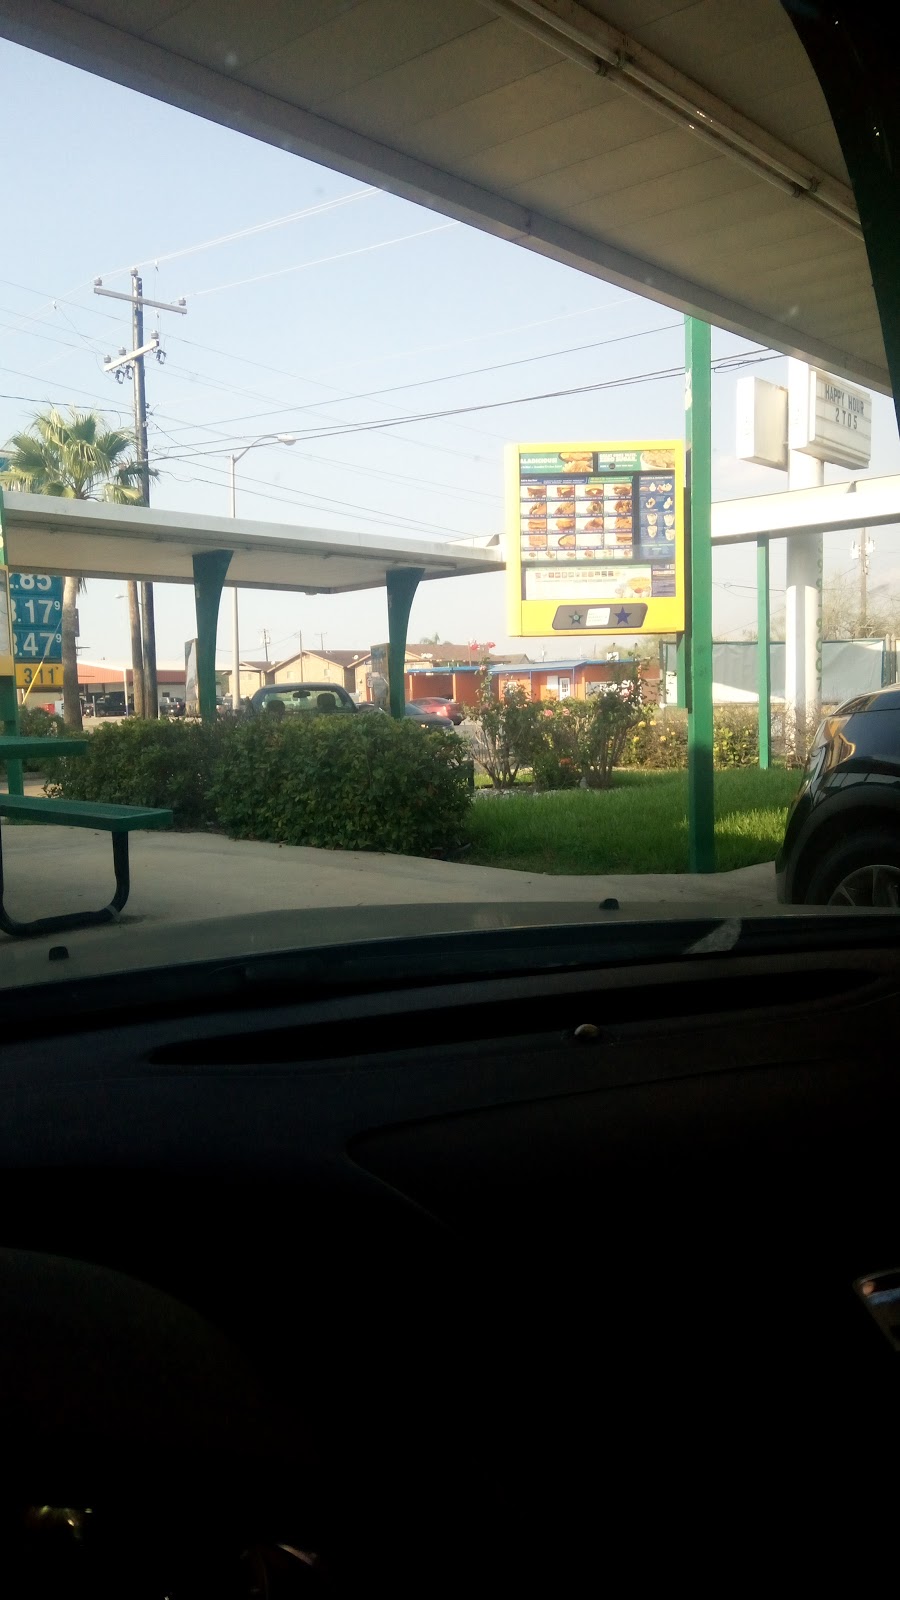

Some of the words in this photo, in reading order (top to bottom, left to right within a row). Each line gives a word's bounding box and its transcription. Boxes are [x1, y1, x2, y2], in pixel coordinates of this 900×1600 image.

[825, 384, 845, 402] HAPPY
[848, 395, 865, 415] HOUR
[835, 407, 840, 423] 2
[853, 415, 858, 430] 5
